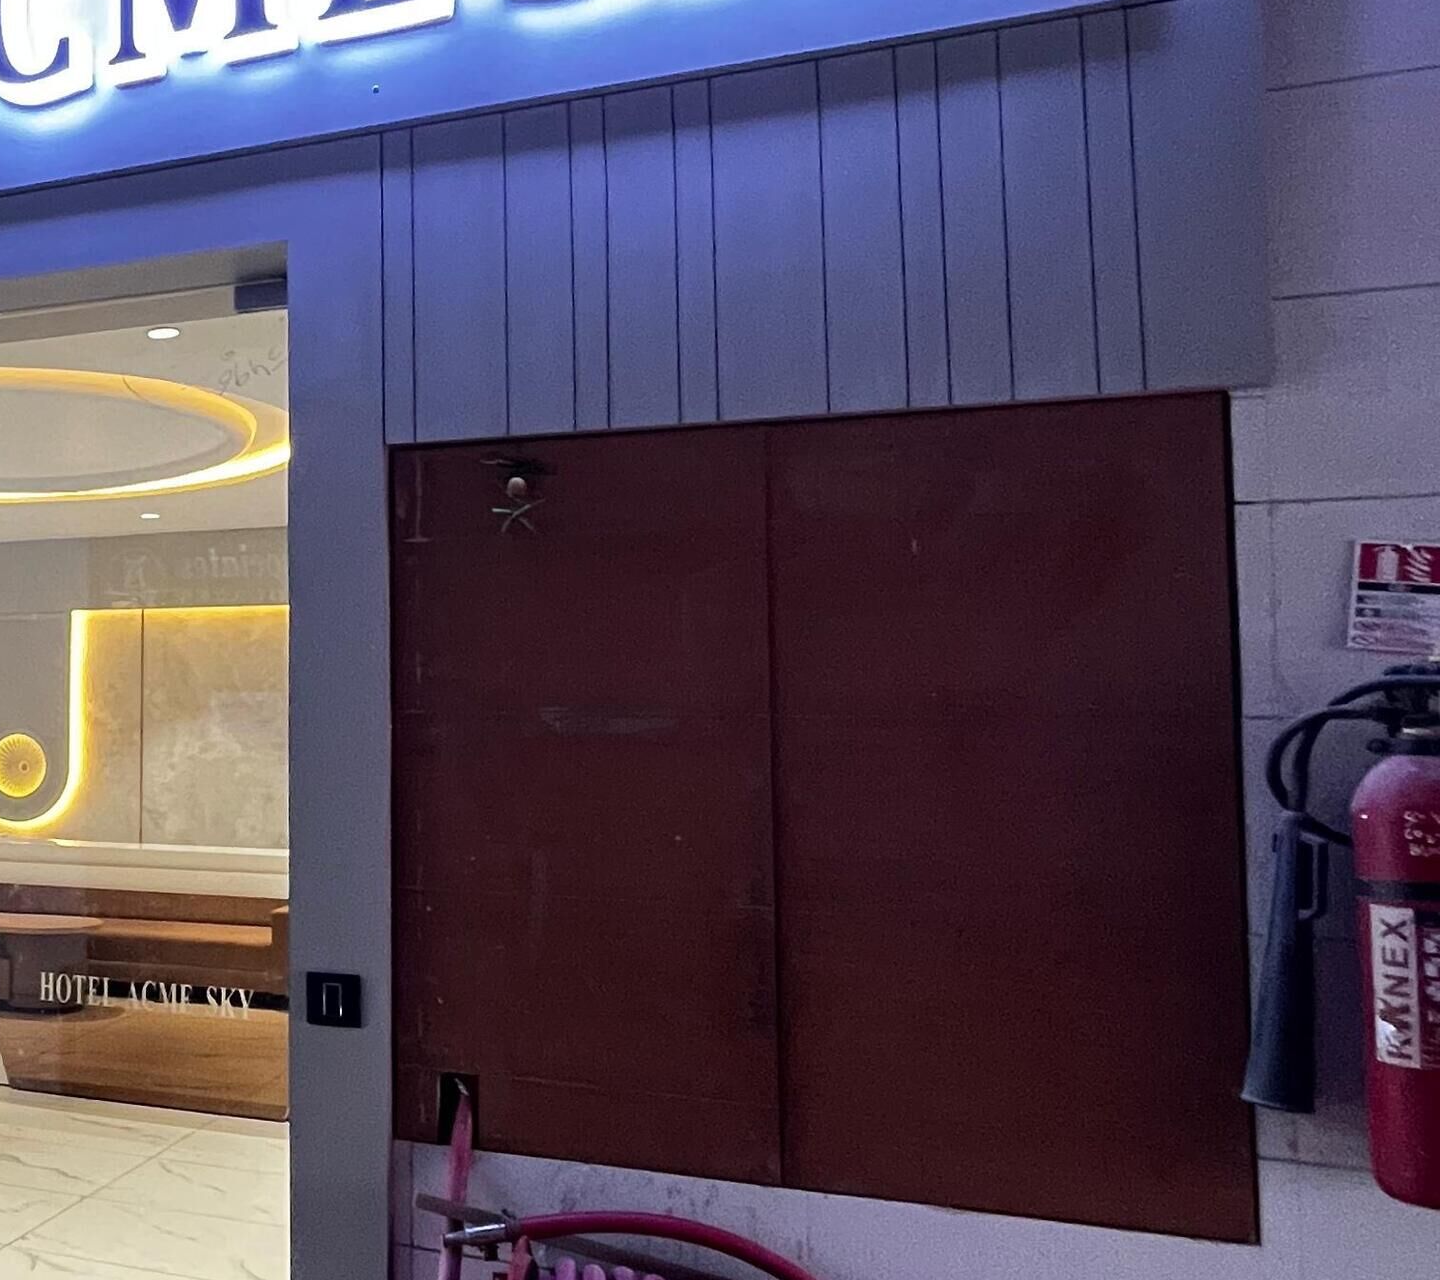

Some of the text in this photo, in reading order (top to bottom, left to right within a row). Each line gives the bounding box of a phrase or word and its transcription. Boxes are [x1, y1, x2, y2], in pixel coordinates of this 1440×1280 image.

[40, 971, 255, 1019] HOTEL ACME SKY
